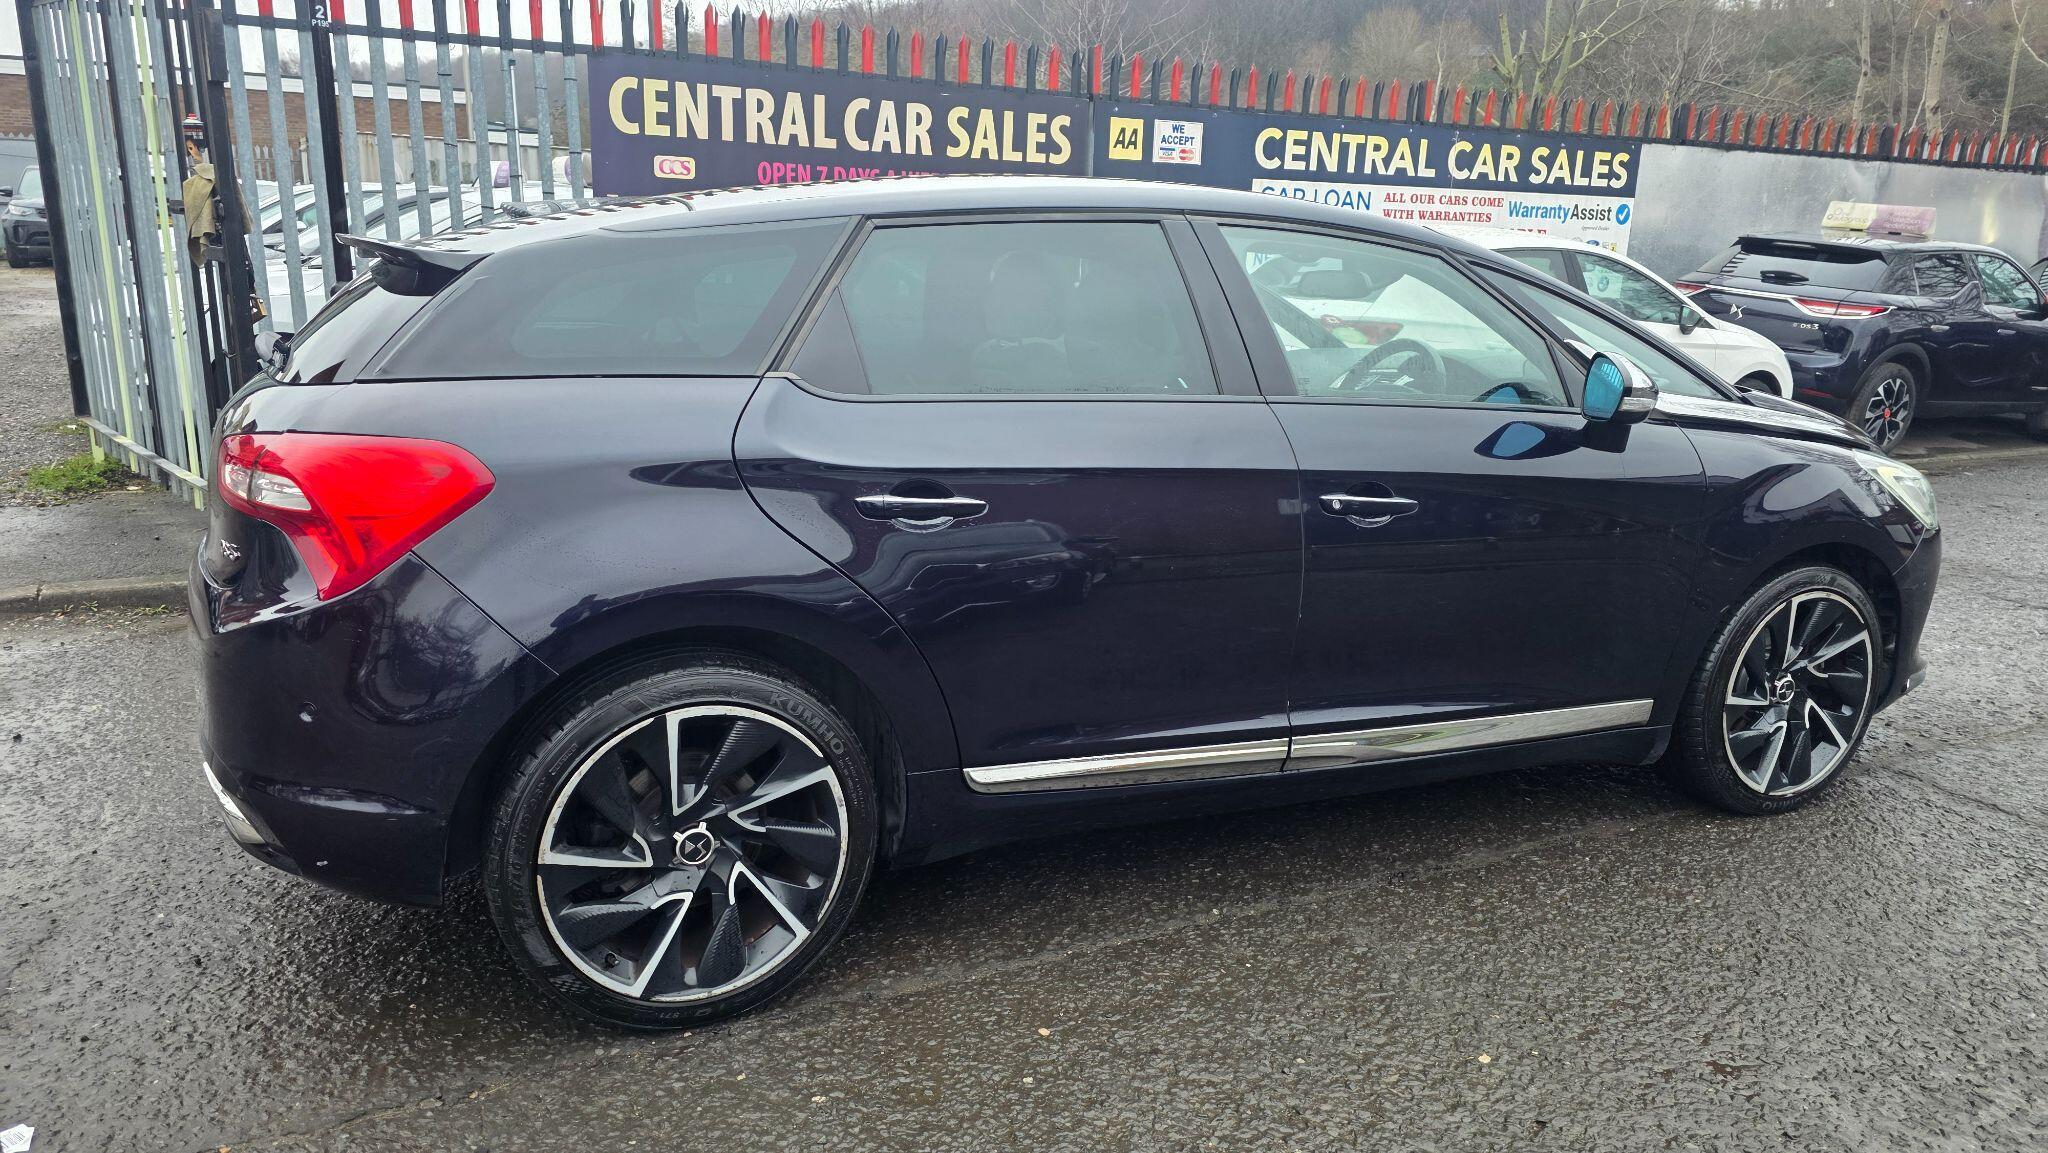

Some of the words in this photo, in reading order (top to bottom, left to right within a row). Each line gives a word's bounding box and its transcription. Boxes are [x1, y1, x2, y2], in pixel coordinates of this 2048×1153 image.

[315, 5, 325, 18] 2
[608, 76, 837, 149] CENTRAL
[844, 98, 933, 156] CAR
[946, 106, 1072, 165] SALES
[1172, 124, 1185, 134] WE
[1113, 127, 1138, 150] AA
[1160, 135, 1195, 147] ACCEPT
[1254, 127, 1436, 178] CENTRAL
[1447, 140, 1520, 183] CAR
[1528, 146, 1631, 189] SALES
[757, 161, 811, 185] OPEN
[816, 166, 828, 181] 7
[1383, 192, 1406, 203] ALL
[1410, 194, 1435, 204] OUR
[1439, 194, 1469, 206] CARS
[1471, 196, 1504, 207] COME
[1383, 208, 1414, 219] WITH
[1418, 210, 1493, 223] WARRANTIES
[769, 693, 845, 755] KUMHO
